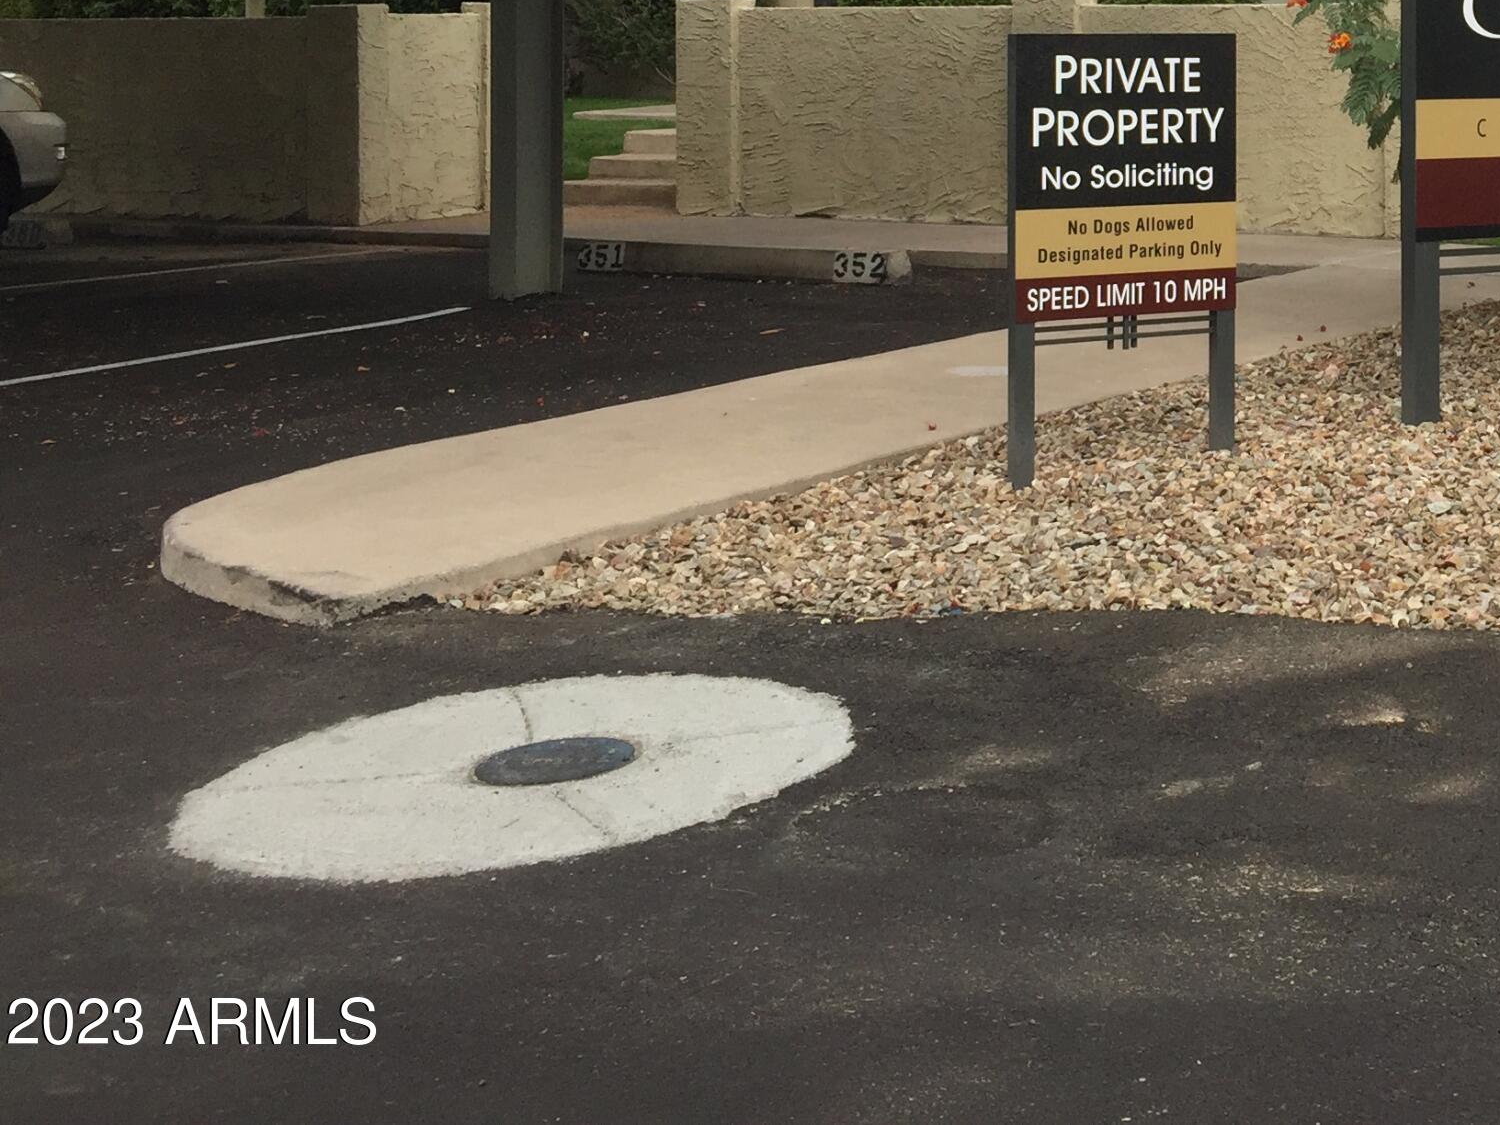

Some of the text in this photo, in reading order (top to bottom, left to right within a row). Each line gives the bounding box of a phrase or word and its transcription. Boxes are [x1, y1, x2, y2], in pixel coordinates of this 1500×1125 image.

[1055, 55, 1201, 94] PRIVATE
[1032, 107, 1225, 147] PROPERTY
[1041, 162, 1214, 191] No Soliciting
[1067, 215, 1194, 235] No Dogs Allowed
[577, 243, 624, 269] 351
[833, 251, 888, 281] 352
[1038, 240, 1222, 265] Designated Parking Only
[1027, 277, 1226, 312] SPEED LIMIT 10 MPH
